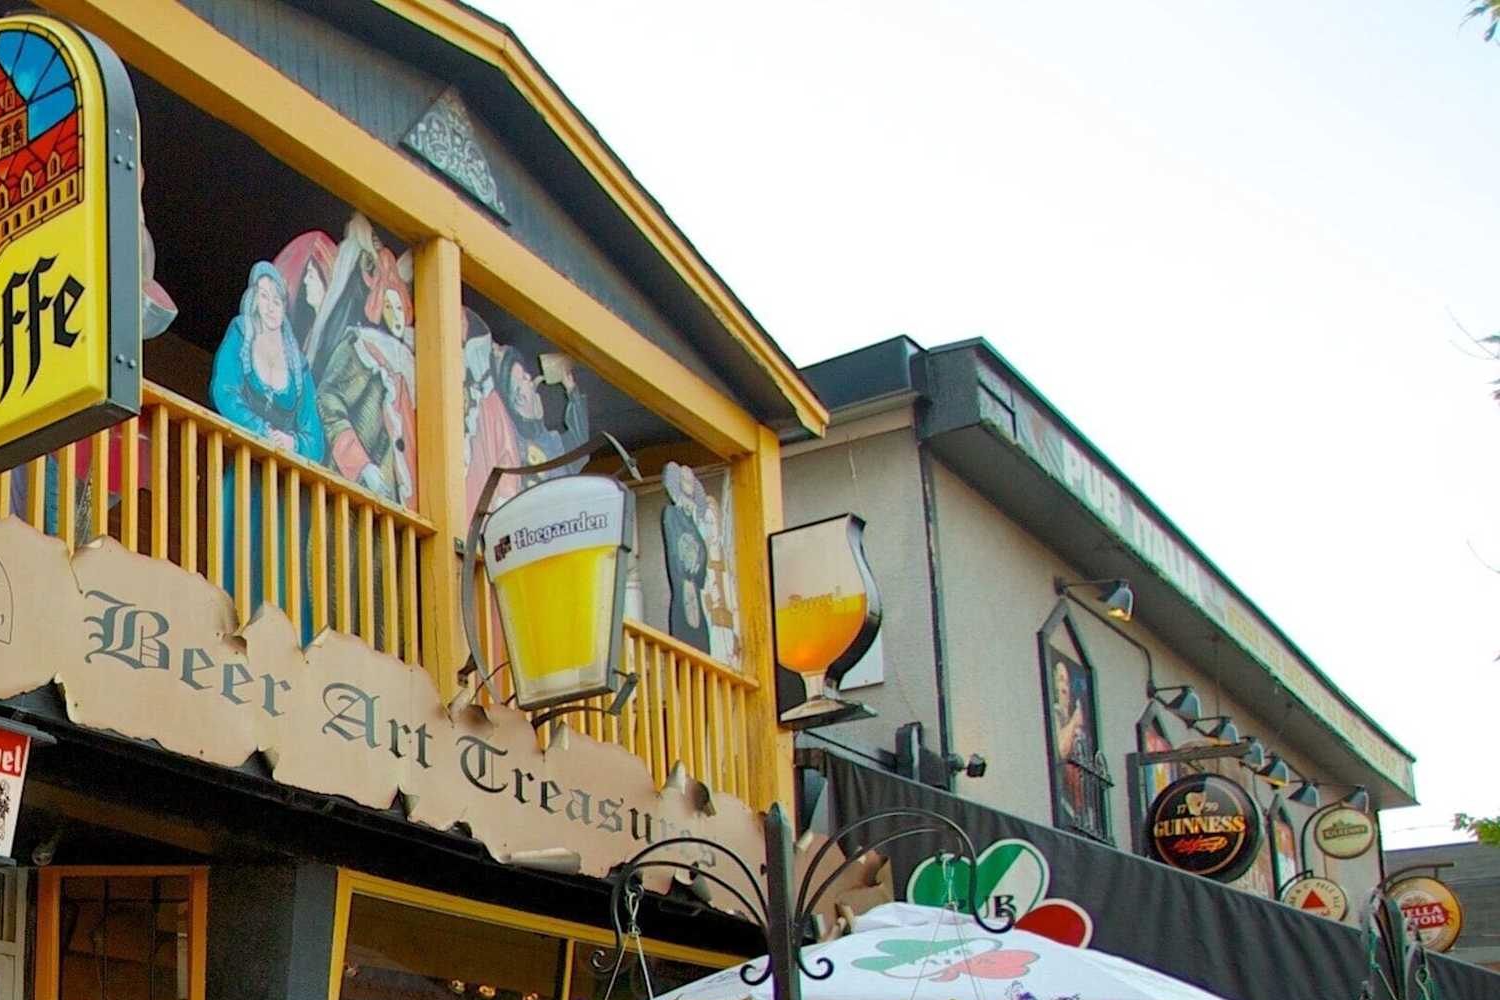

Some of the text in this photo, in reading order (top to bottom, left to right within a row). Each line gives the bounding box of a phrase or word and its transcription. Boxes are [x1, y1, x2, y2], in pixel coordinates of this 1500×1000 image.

[514, 511, 607, 550] Hoegaarden
[83, 589, 292, 718] Beer
[321, 682, 434, 769] Art
[1153, 815, 1246, 837] GUINNESS
